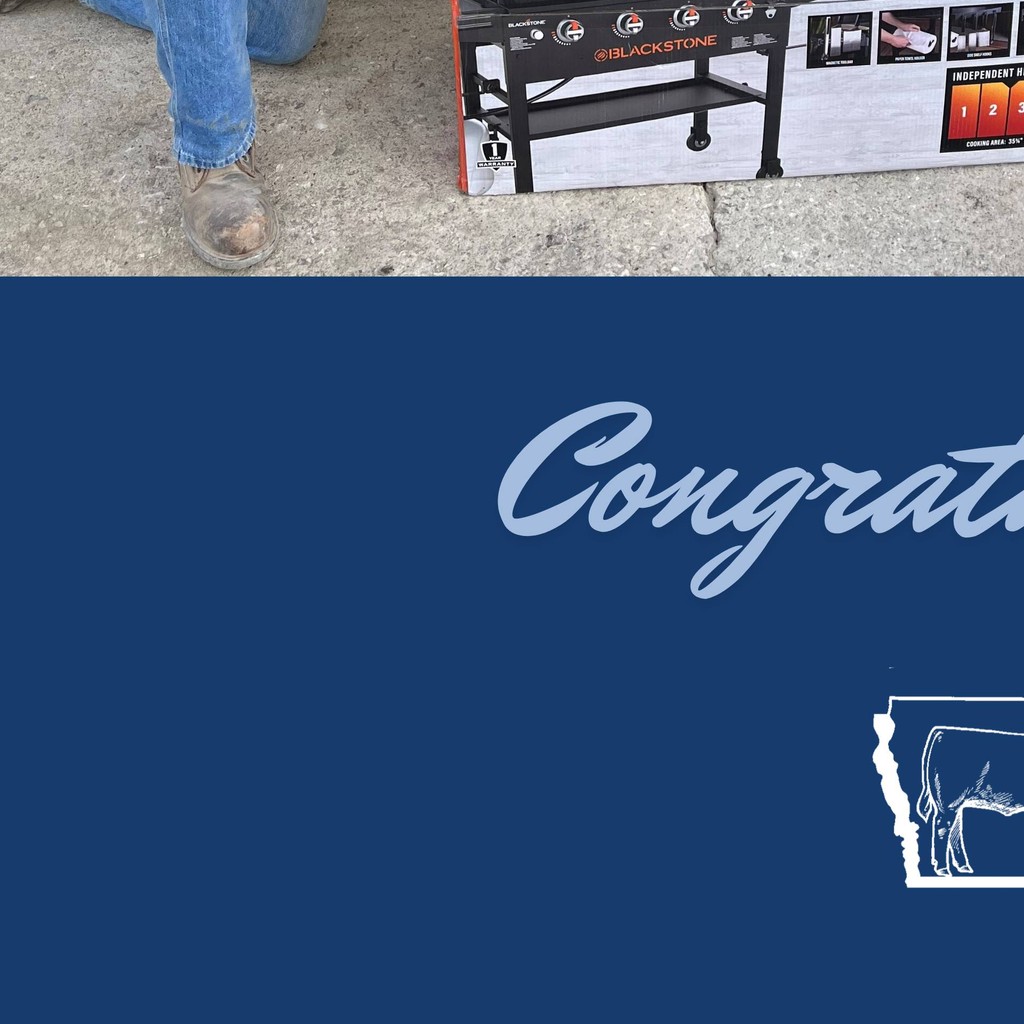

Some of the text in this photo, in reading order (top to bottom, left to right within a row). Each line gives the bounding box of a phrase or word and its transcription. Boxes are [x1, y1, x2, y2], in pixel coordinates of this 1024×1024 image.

[508, 20, 547, 28] BLACKSTONE
[608, 34, 718, 60] BLACKSTONE
[952, 67, 1015, 82] INDEPENDENT
[961, 105, 967, 118] 1
[988, 103, 998, 116] 2
[491, 143, 498, 157] 1
[966, 139, 990, 148] COOKING
[989, 138, 1007, 146] AREA:
